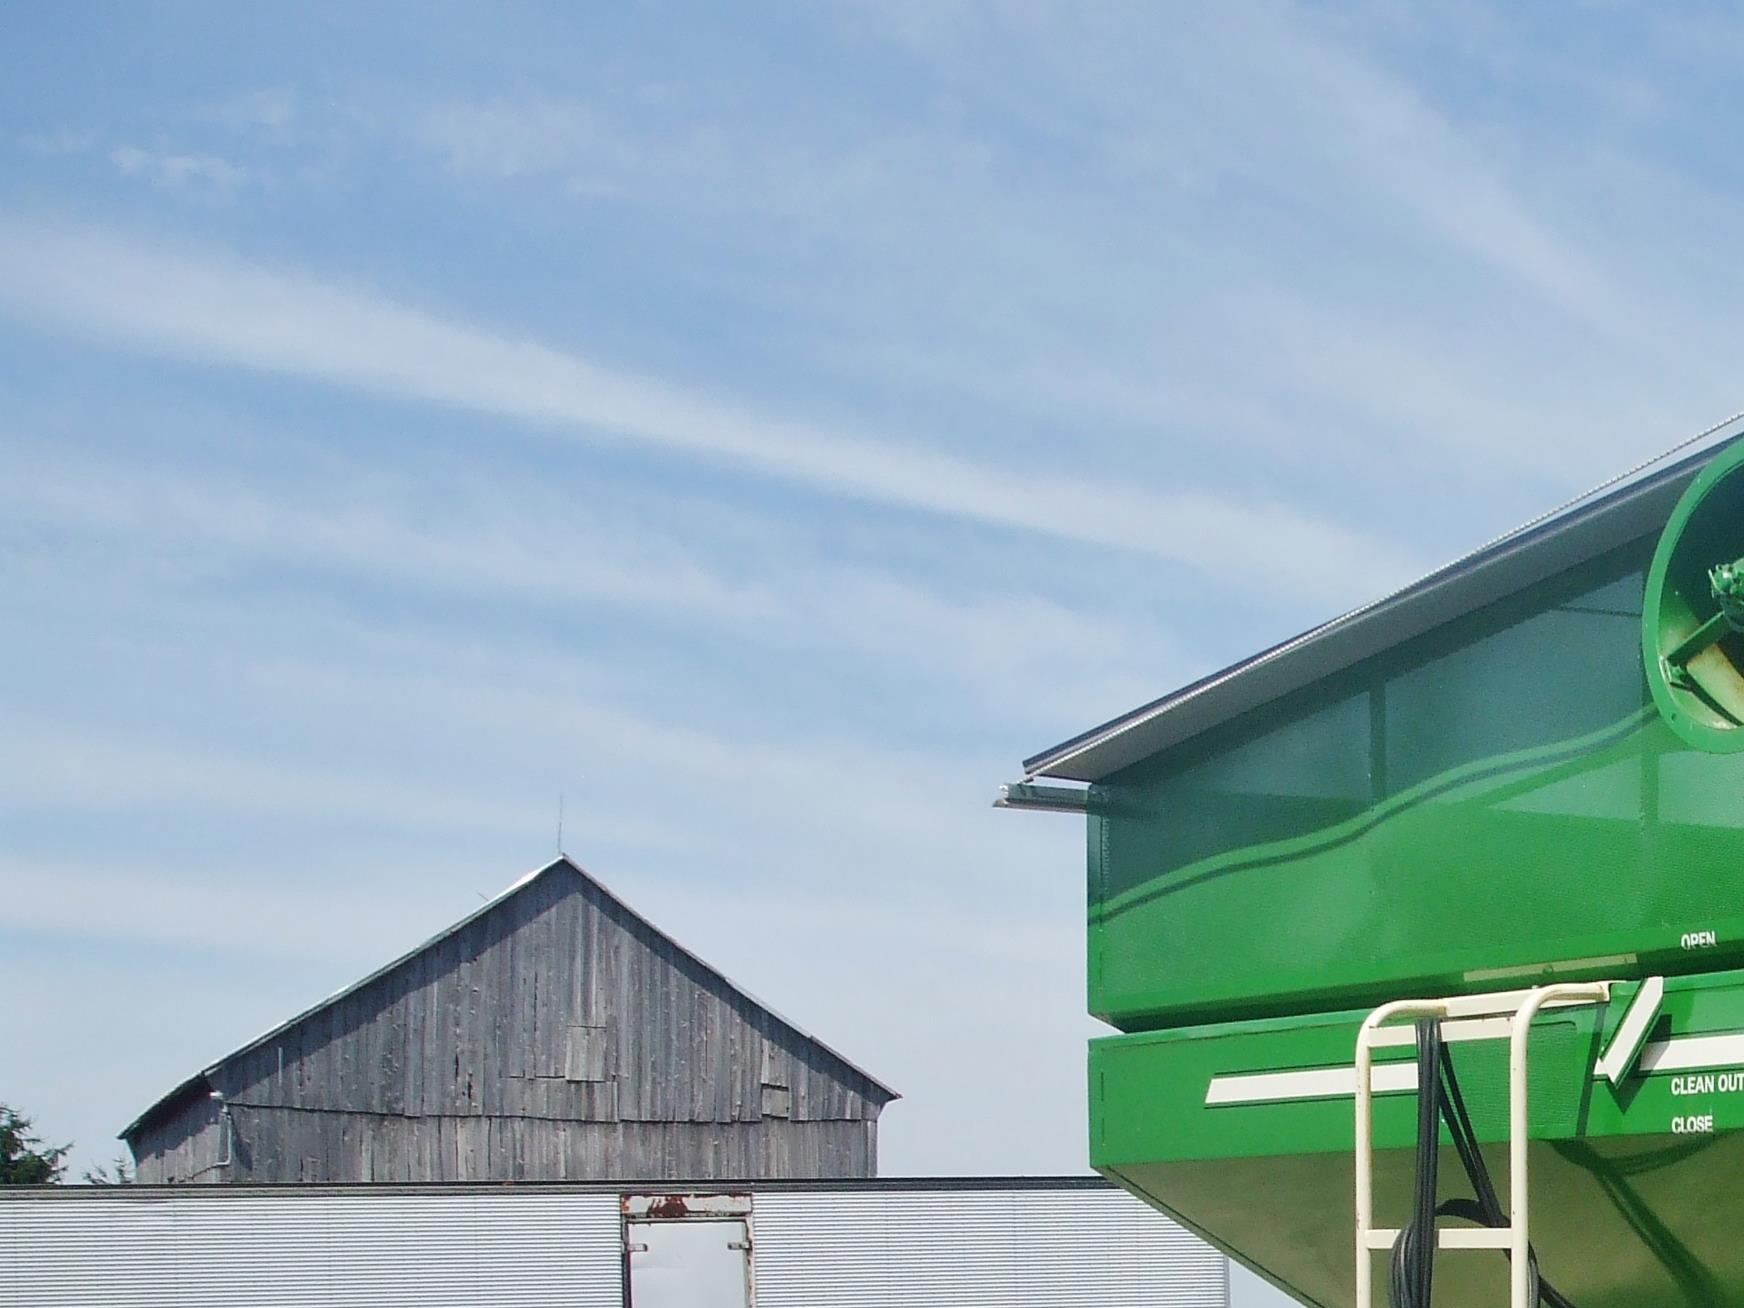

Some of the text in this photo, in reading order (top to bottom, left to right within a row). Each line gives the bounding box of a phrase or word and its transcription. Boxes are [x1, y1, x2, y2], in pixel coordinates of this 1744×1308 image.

[1681, 930, 1717, 950] OPEN
[1671, 1075, 1715, 1096] CLEAN
[1671, 1115, 1713, 1134] CLOSE
